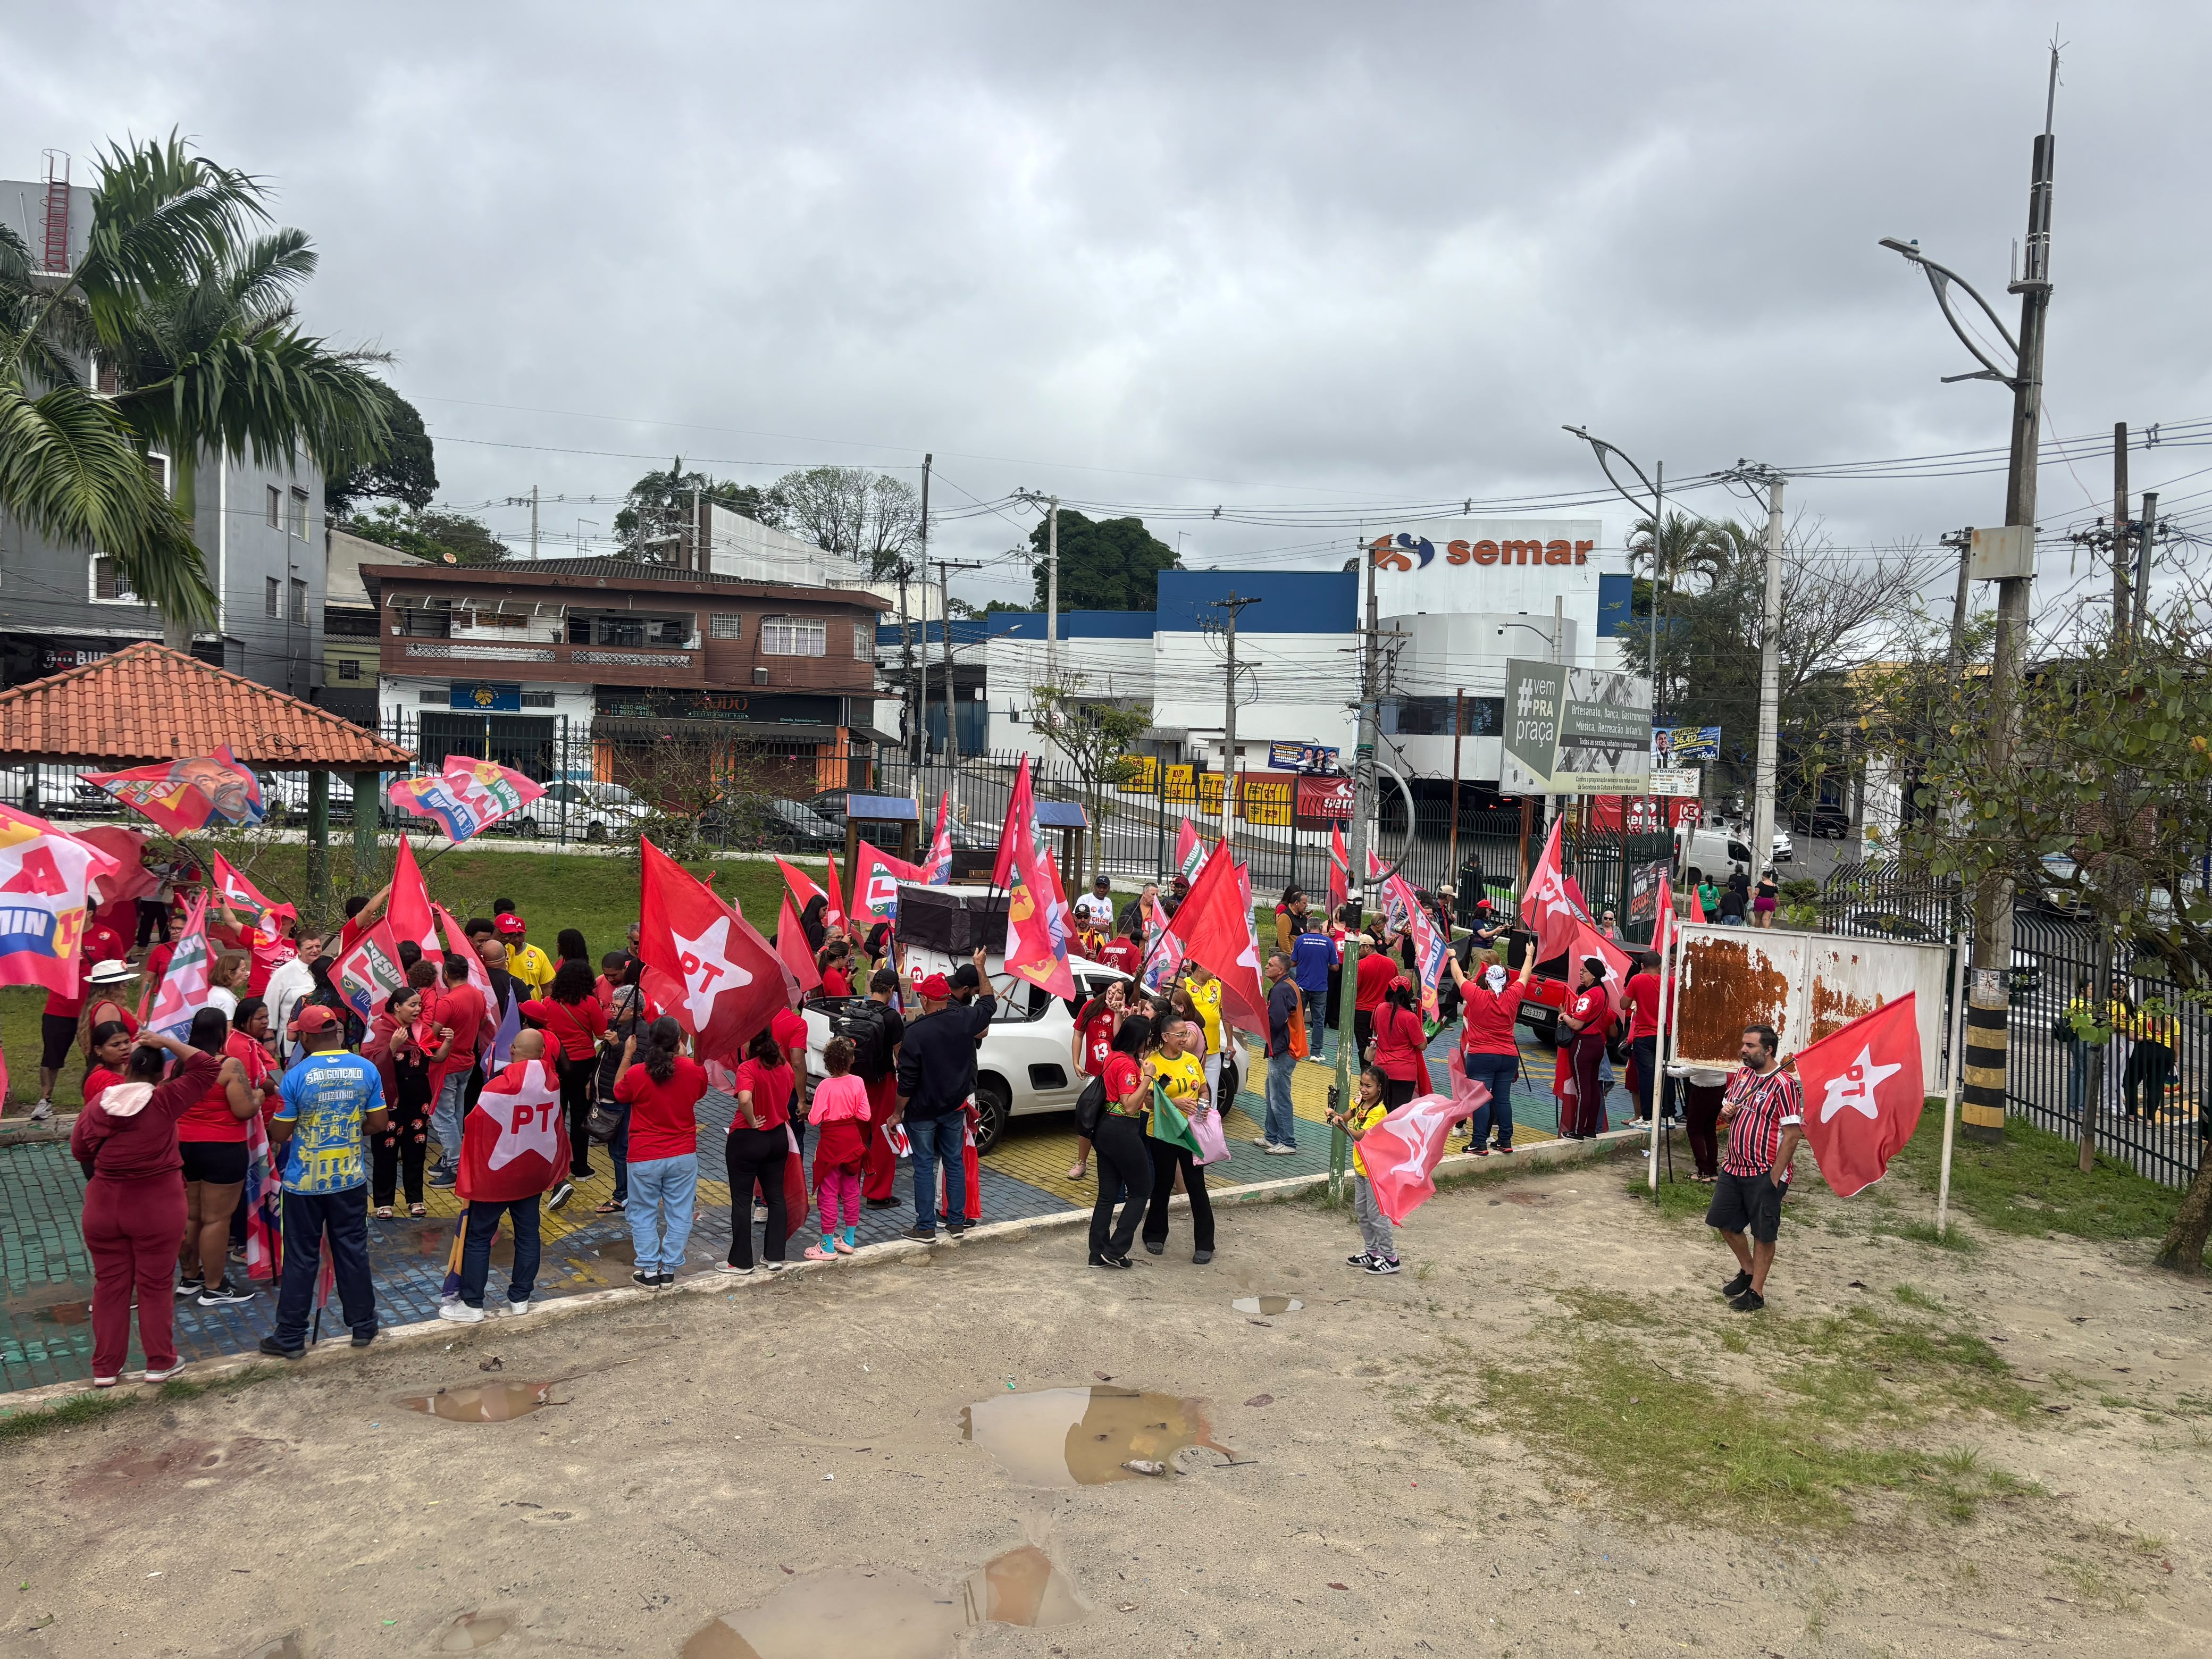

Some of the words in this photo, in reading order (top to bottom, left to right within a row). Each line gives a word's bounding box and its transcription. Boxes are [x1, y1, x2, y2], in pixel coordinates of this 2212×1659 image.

[1446, 539, 1594, 565] semar
[1534, 679, 1555, 696] vem
[1532, 699, 1554, 717] PRA
[1571, 705, 1602, 719] Artesanato,
[1604, 708, 1620, 720] Dança,
[1622, 710, 1650, 723] Gastronomia
[1515, 719, 1554, 748] praça
[1575, 720, 1596, 733] Música,
[1598, 723, 1623, 736] Recreação
[1579, 737, 1589, 745] Todas
[1595, 739, 1606, 748] sextas,
[1606, 739, 1620, 748] sábados
[1623, 741, 1638, 750] domingos
[1674, 734, 1697, 745] 56.412
[1542, 876, 1564, 906] PT
[681, 950, 725, 994] PT
[1093, 1042, 1109, 1061] 13
[306, 1068, 325, 1085] SÃO
[326, 1068, 363, 1080] GONÇALO
[1176, 1077, 1188, 1094] 11
[1841, 1064, 1866, 1098] PT
[319, 1091, 354, 1101] LUIZINHO
[510, 1101, 554, 1134] PT
